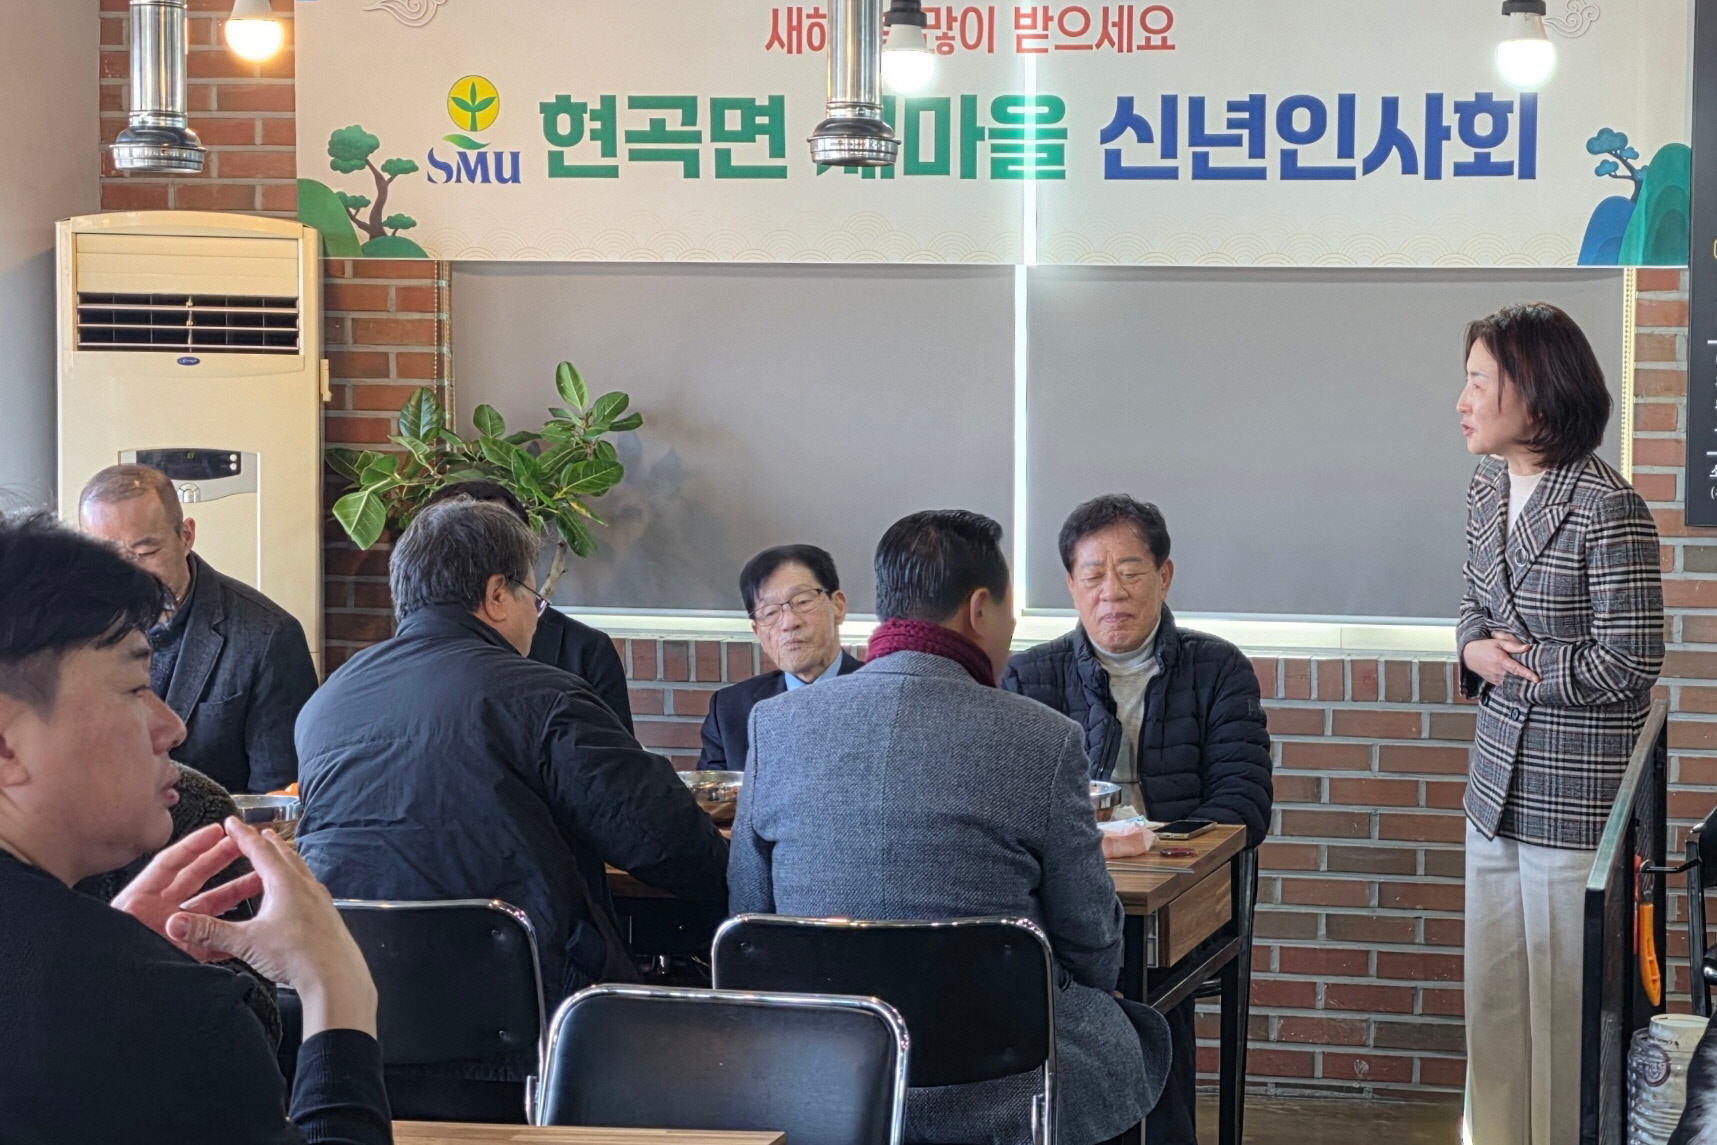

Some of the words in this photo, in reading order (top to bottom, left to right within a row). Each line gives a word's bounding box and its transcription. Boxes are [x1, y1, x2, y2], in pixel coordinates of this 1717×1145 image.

[1015, 5, 1175, 54] 받으세요
[539, 94, 788, 179] 현곡면
[816, 94, 1068, 180] 마을
[1100, 92, 1537, 180] 신년인사회
[427, 146, 521, 184] SMU
